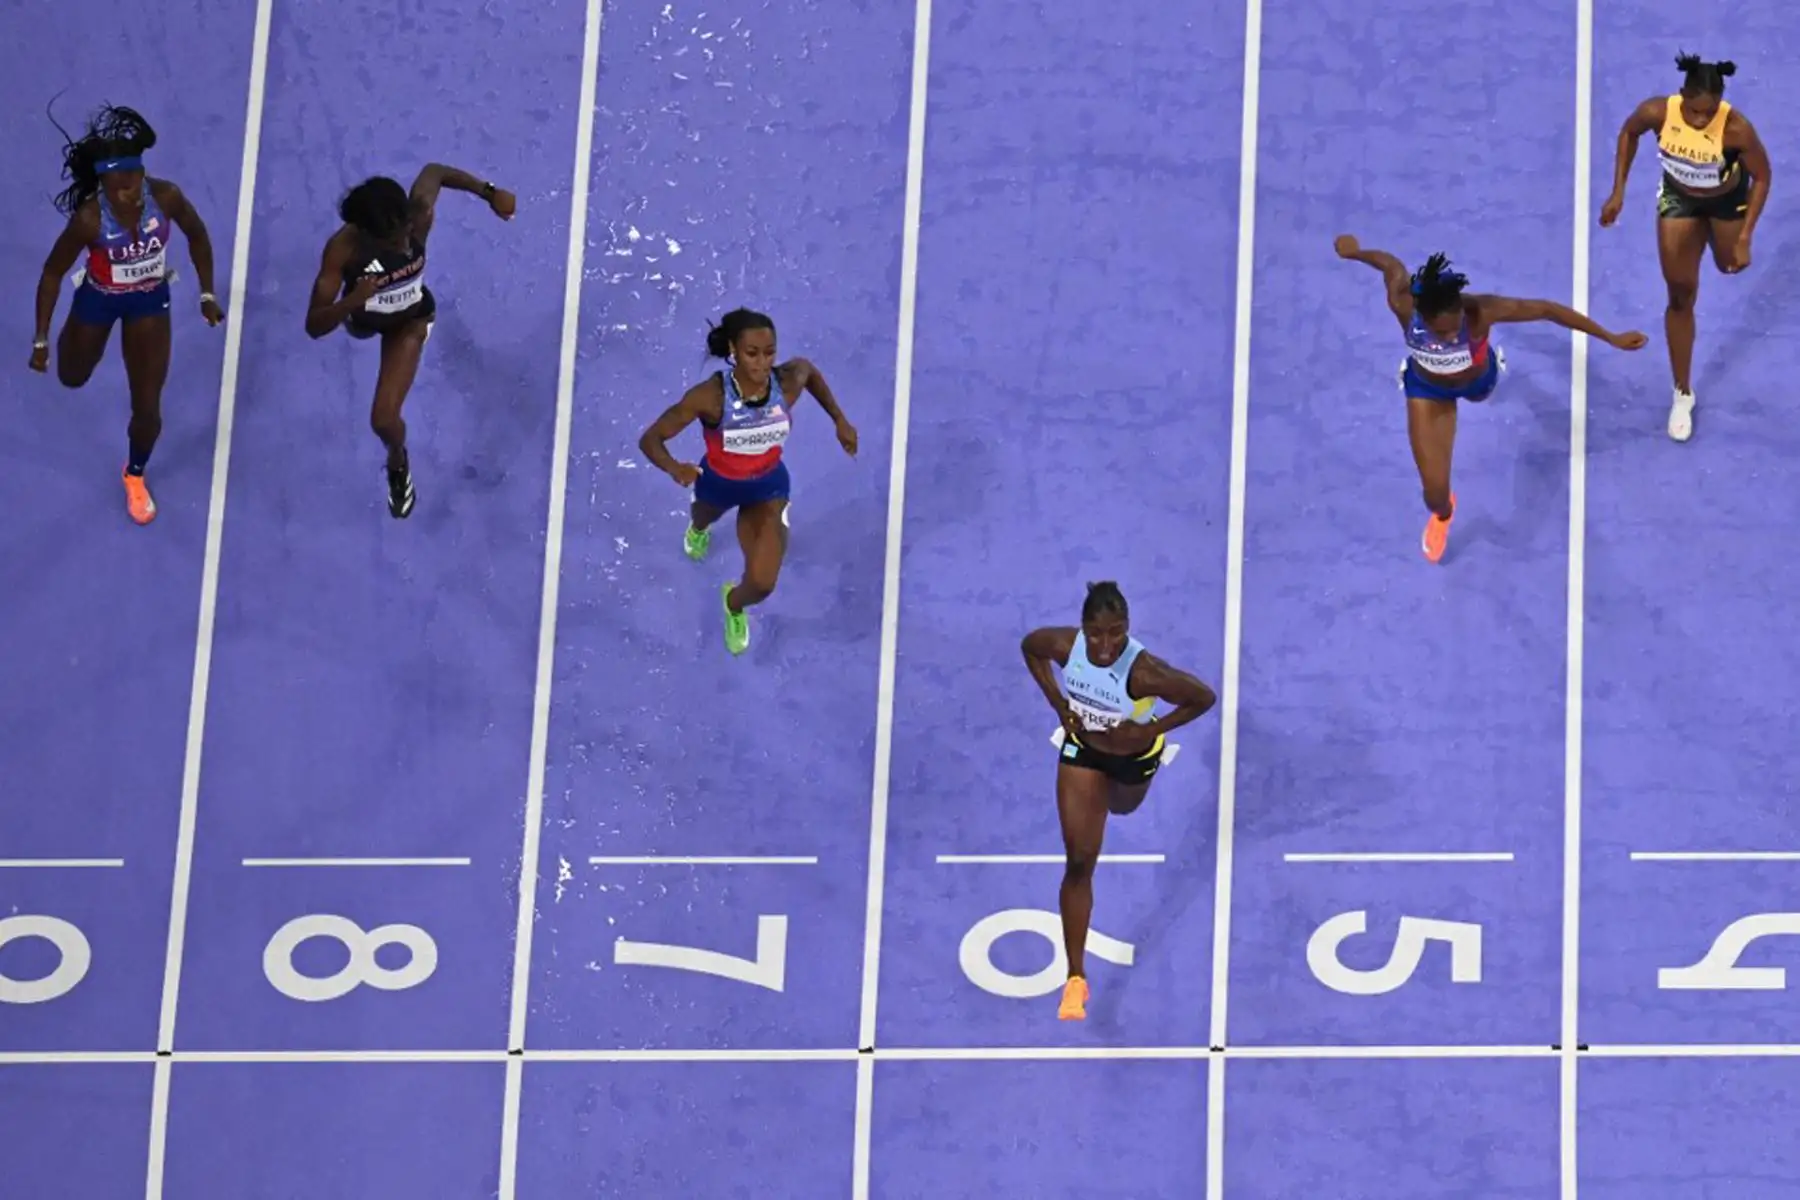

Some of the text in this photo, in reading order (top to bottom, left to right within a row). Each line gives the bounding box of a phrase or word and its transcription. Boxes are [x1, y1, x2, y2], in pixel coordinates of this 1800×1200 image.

[1665, 142, 1719, 163] JAMAICA
[109, 236, 162, 260] USA
[1066, 676, 1090, 693] SAINT
[263, 914, 438, 1001] 8
[613, 915, 788, 992] 7
[959, 908, 1134, 997] 6
[1306, 910, 1482, 994] 5
